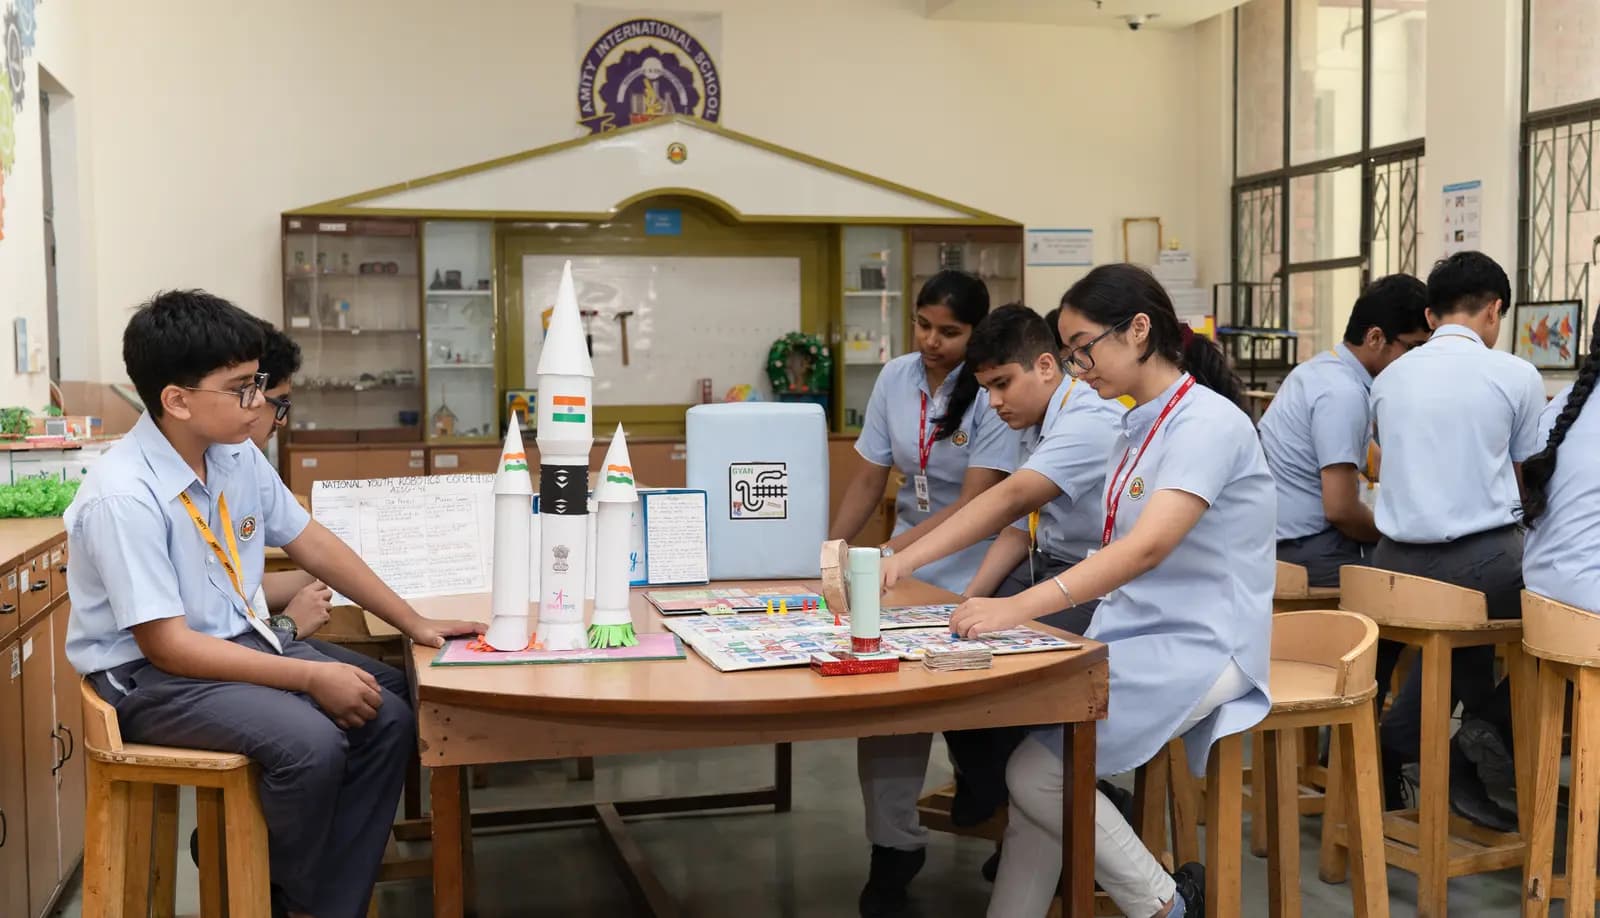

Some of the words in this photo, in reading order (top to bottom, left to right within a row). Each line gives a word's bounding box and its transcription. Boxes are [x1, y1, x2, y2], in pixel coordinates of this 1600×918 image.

[580, 59, 597, 113] AMITY
[595, 22, 692, 59] INTERNATIONAL
[694, 51, 718, 119] SCHOOL
[732, 466, 754, 475] GYAN
[322, 479, 363, 489] NATIONAL
[367, 477, 393, 487] YOUTH
[398, 475, 441, 486] ROBOTICS
[446, 473, 496, 484] COMPETITIO
